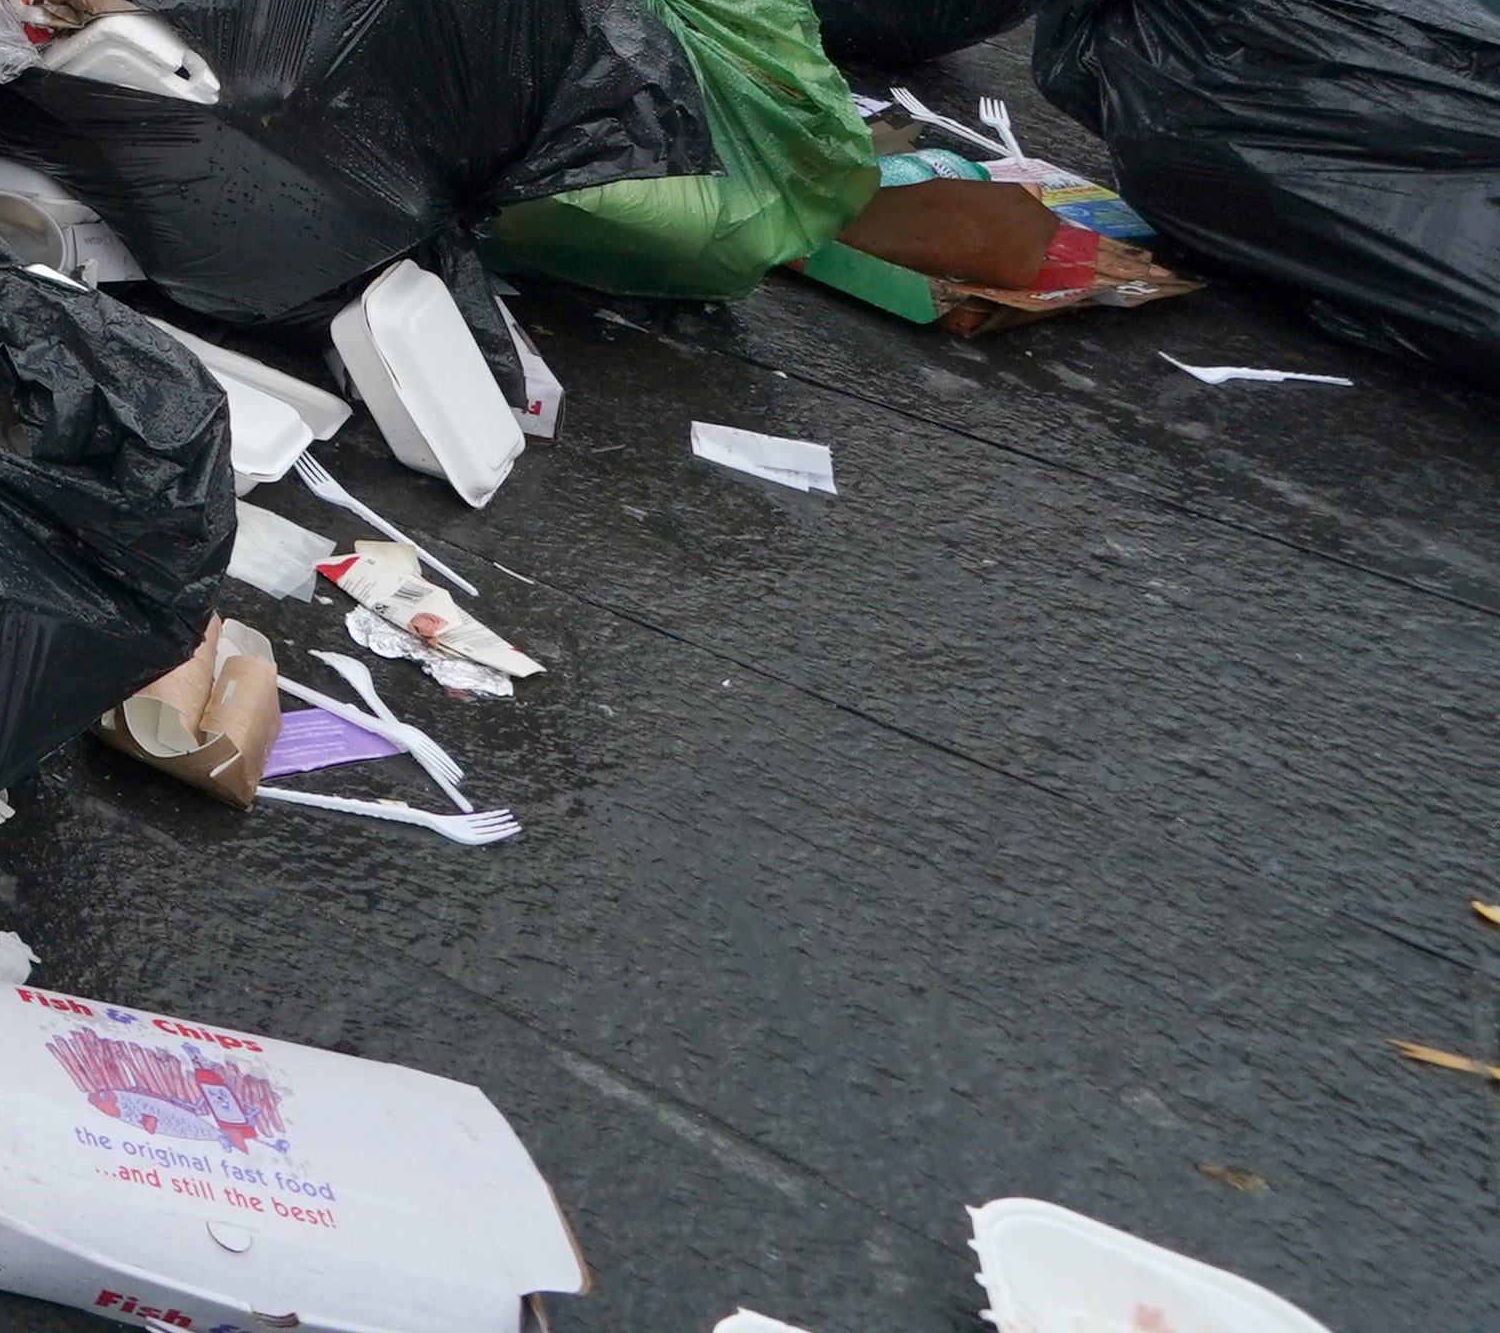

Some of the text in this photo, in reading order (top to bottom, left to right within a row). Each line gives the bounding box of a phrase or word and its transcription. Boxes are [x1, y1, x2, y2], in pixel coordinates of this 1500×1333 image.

[16, 987, 265, 1053] Fish & Chips
[74, 1125, 337, 1202] the original fast food
[94, 1166, 338, 1229] ...and still the best!
[95, 1289, 194, 1330] Fish
